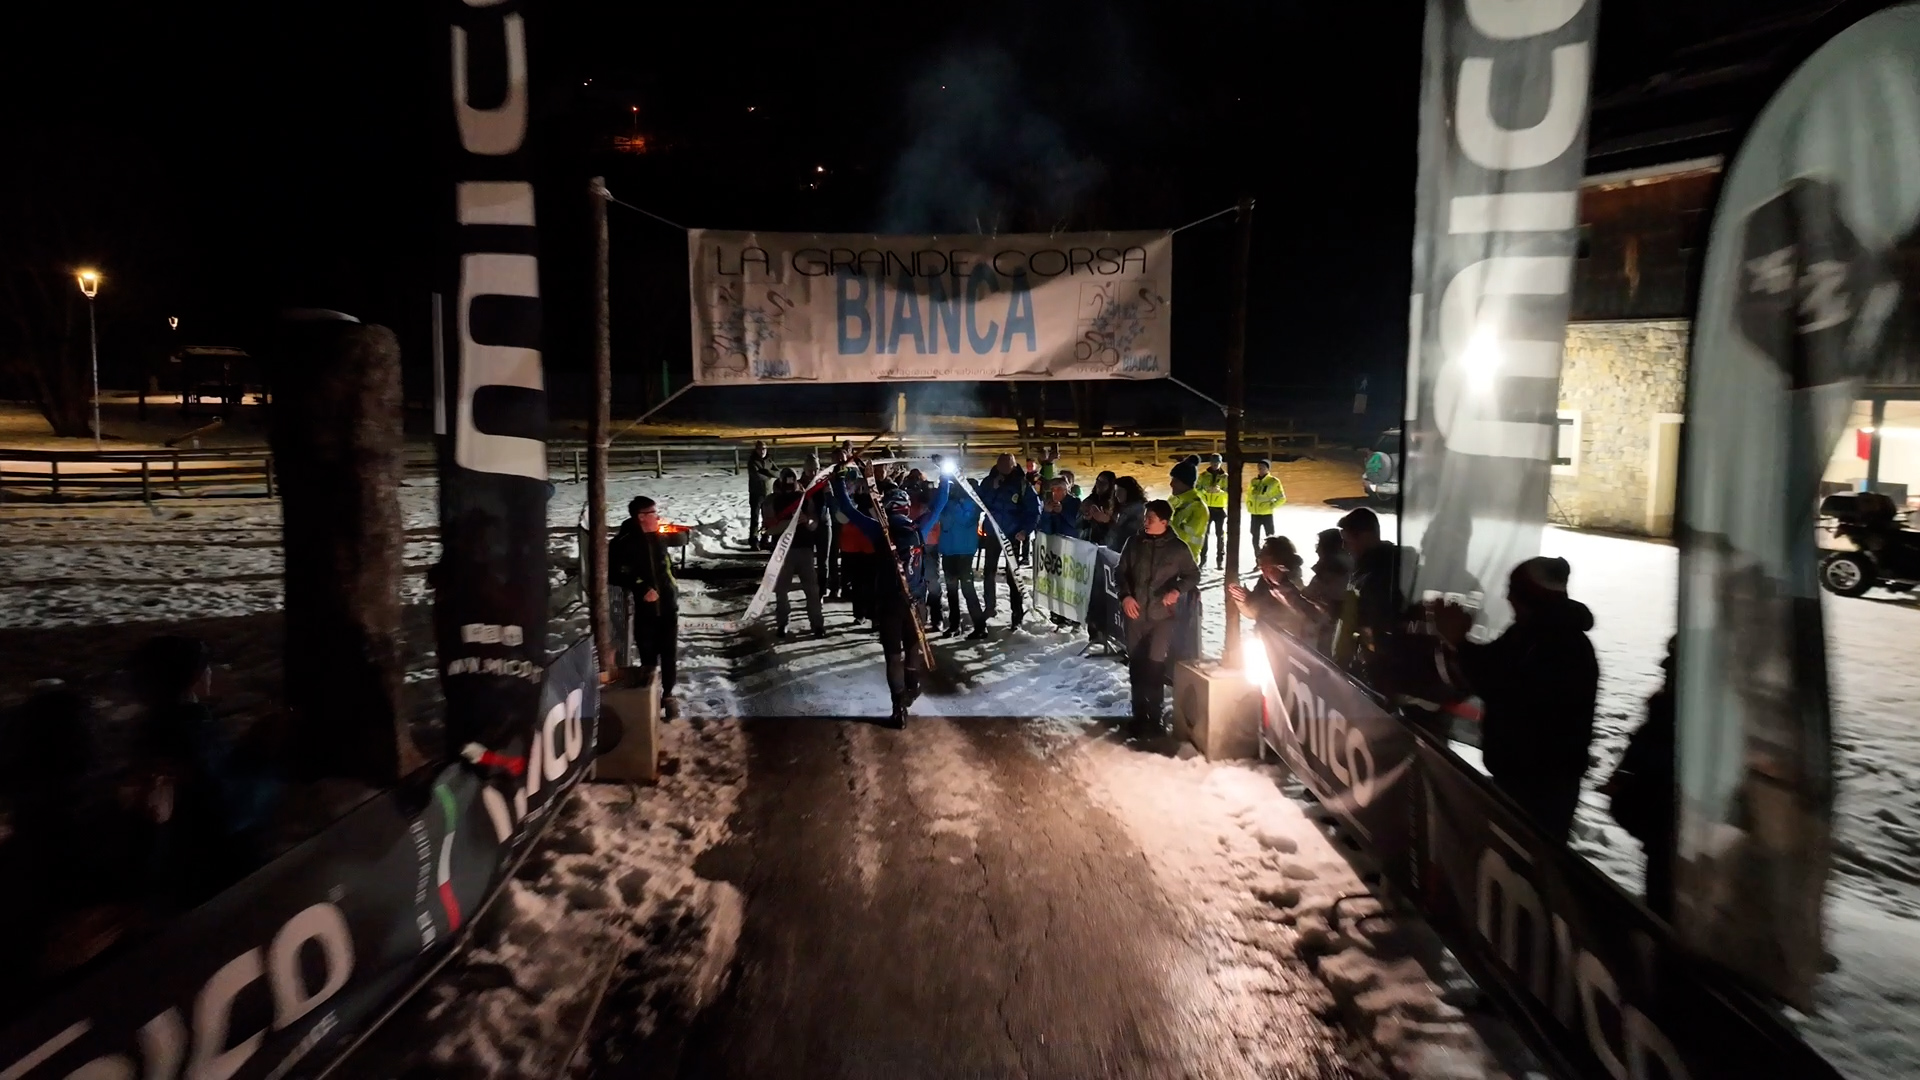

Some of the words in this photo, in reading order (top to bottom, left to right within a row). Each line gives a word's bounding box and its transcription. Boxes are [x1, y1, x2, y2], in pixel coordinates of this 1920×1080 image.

[450, 0, 548, 480] mic
[717, 246, 769, 276] LA
[792, 247, 971, 278] GRANDE
[993, 246, 1146, 277] CORSA
[836, 263, 1037, 355] BIANCA
[1283, 671, 1376, 809] mico
[62, 902, 355, 1080] ico
